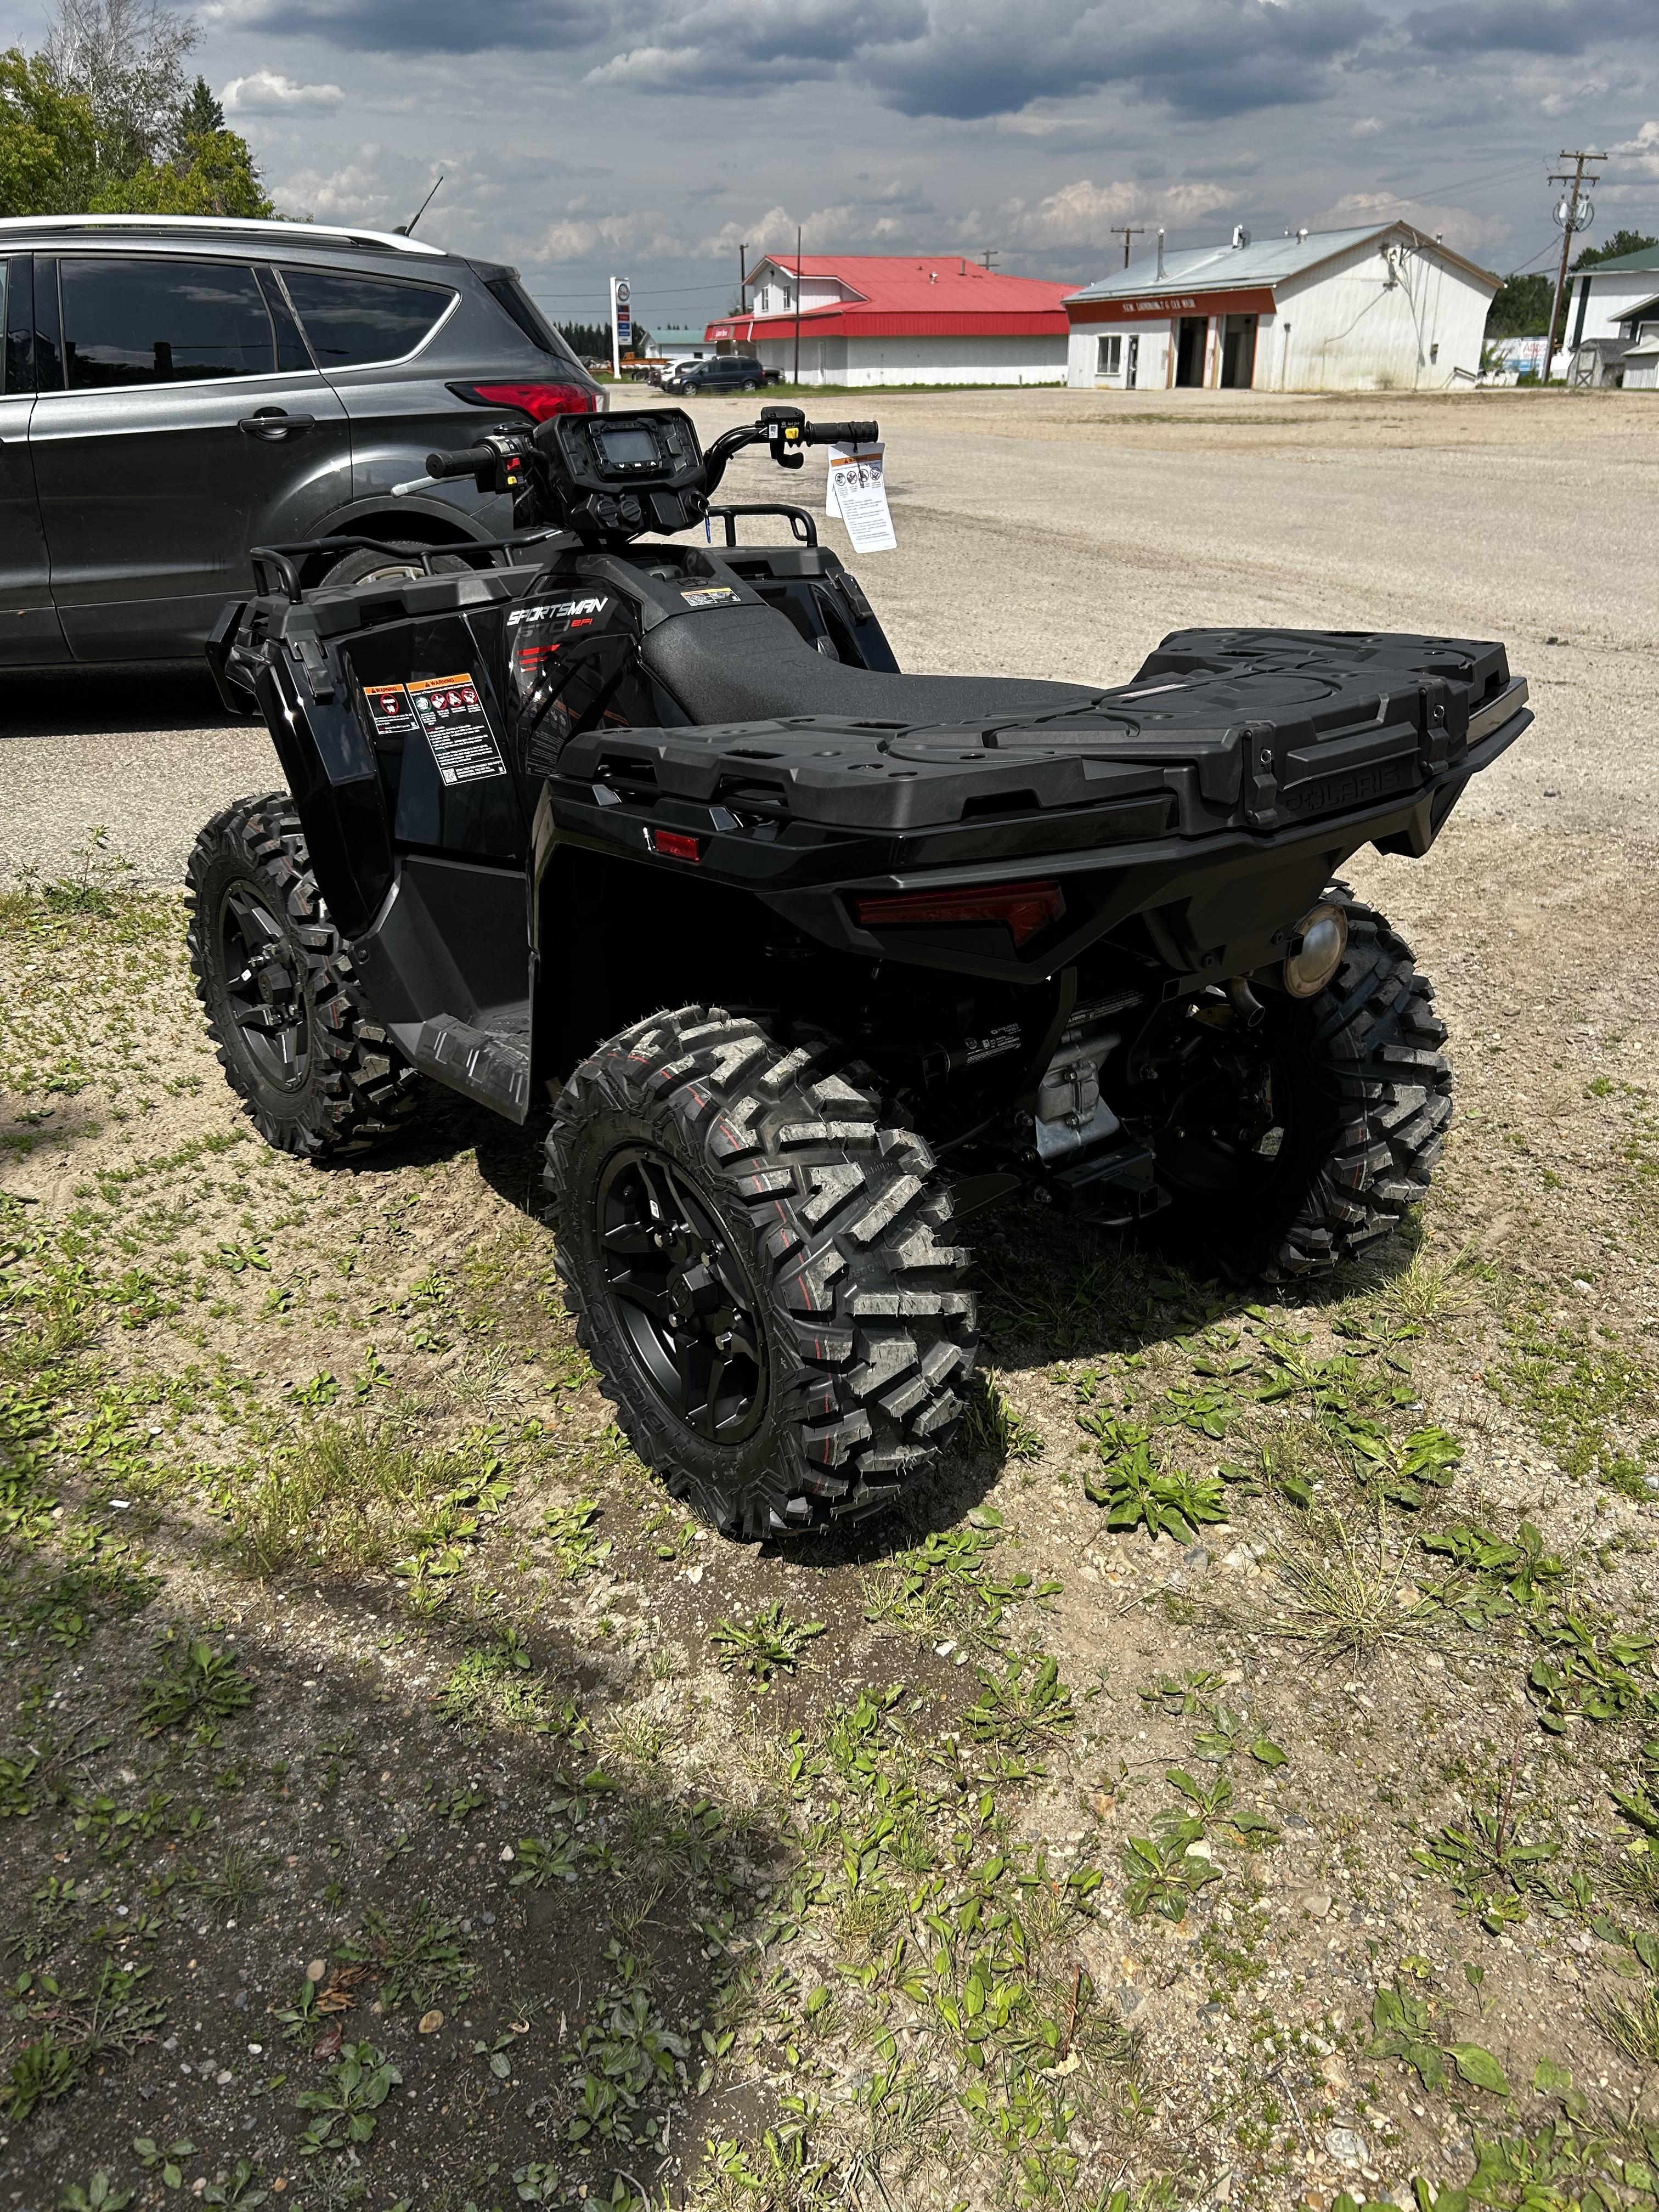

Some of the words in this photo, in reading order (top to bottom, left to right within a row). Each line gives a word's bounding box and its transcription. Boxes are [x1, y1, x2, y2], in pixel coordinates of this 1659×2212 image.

[507, 597, 608, 626] SPORTSMAN
[517, 619, 571, 638] 570
[571, 618, 593, 627] EFI
[1285, 768, 1401, 812] POLARIS
